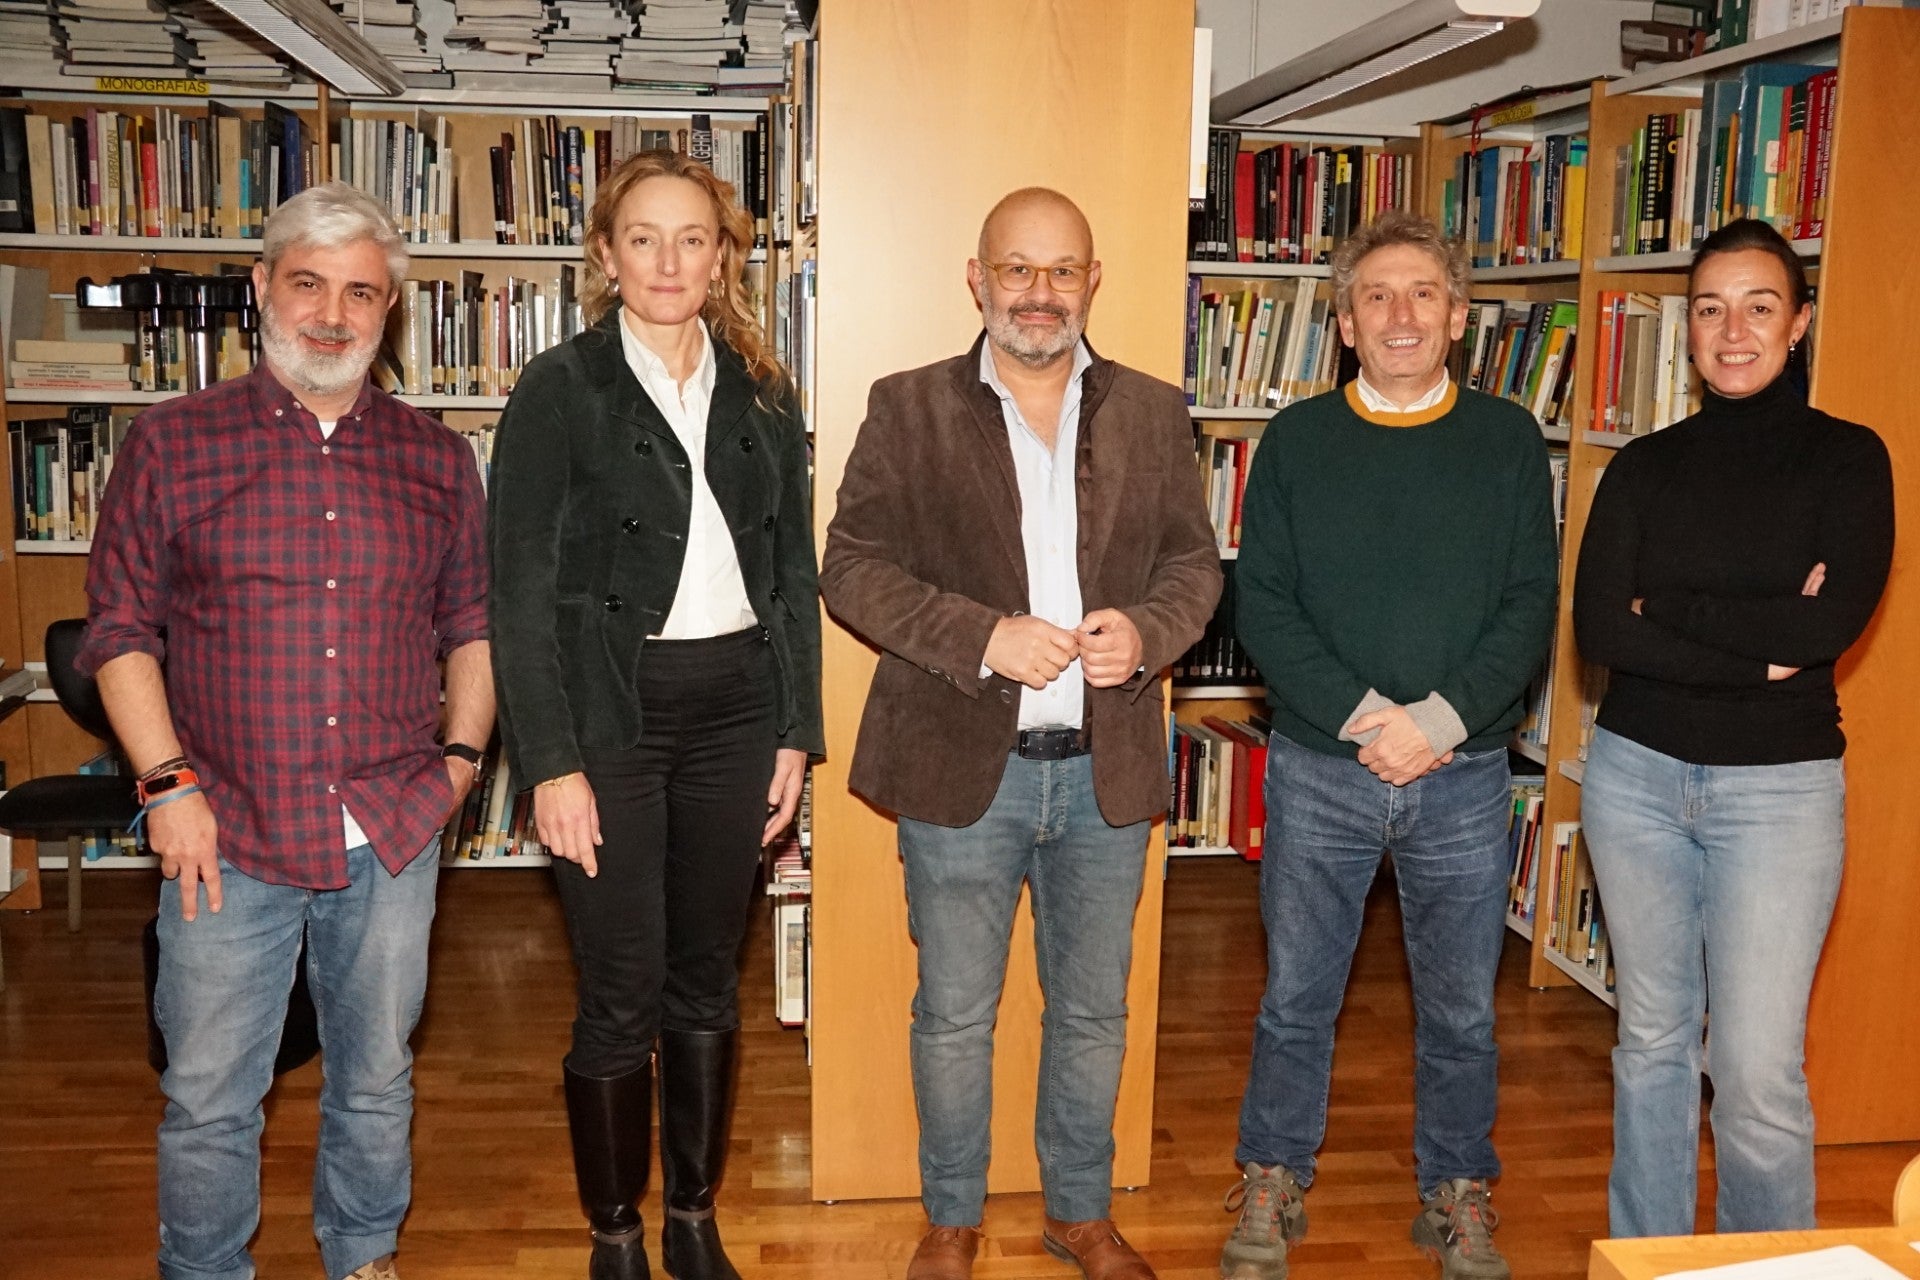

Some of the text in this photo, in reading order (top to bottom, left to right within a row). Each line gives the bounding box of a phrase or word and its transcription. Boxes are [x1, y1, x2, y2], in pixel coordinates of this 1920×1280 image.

[100, 77, 206, 93] MONOGRAFIAS
[107, 130, 120, 189] BARRAGAN
[692, 129, 712, 158] GEHRY
[1547, 141, 1555, 187] Architecture
